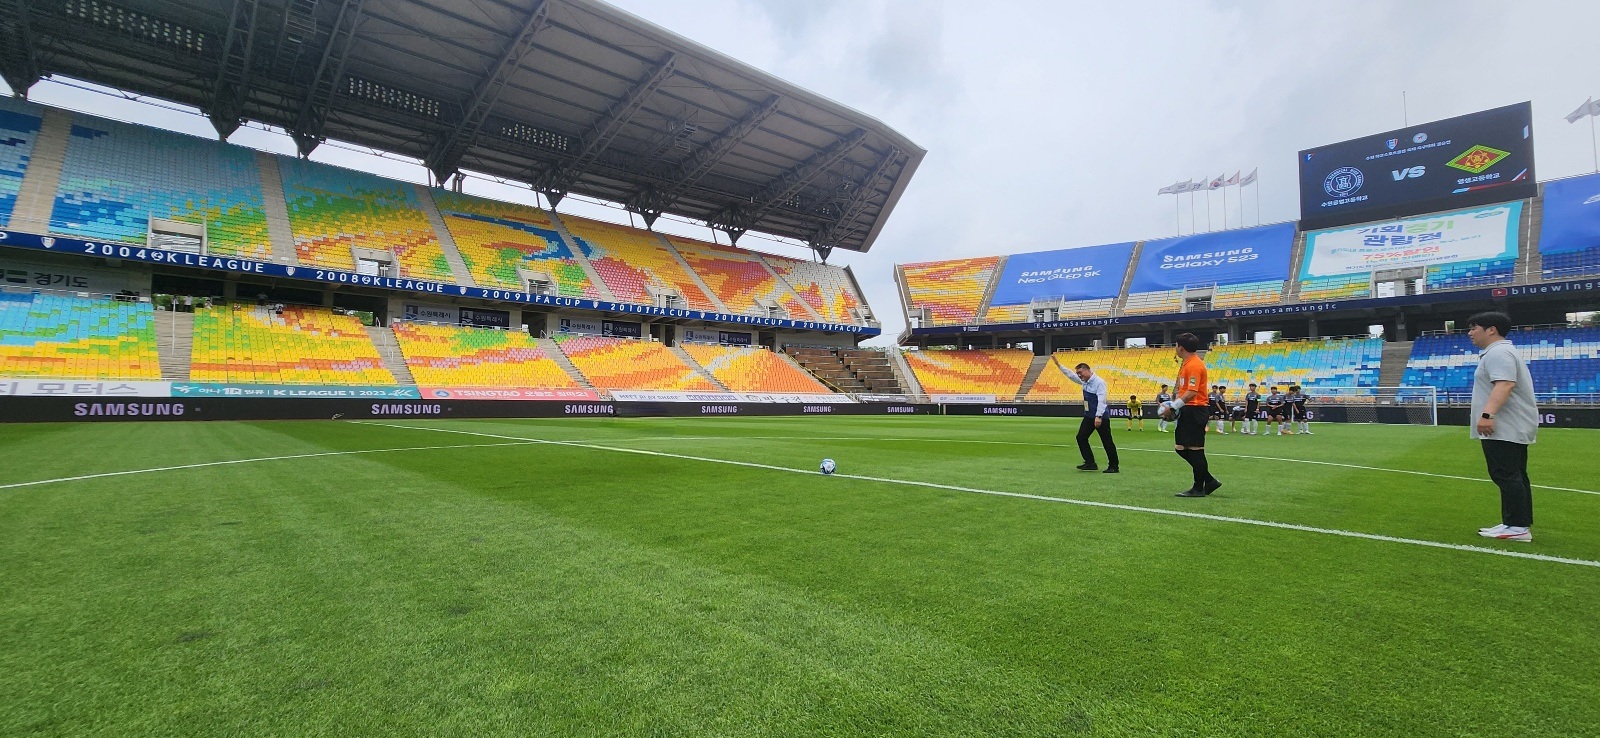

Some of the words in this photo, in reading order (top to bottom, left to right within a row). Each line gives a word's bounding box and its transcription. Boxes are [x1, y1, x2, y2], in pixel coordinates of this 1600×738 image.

[1391, 165, 1426, 181] VS
[84, 242, 147, 260] 2004
[166, 252, 177, 263] K
[185, 254, 264, 273] LEAGUE
[1163, 247, 1253, 262] SAMSUNG
[1160, 258, 1223, 270] Galaxy
[1226, 253, 1259, 264] S23
[1017, 275, 1045, 284] Neo
[1047, 271, 1081, 280] QLED
[1083, 269, 1101, 277] 8K
[1020, 265, 1093, 277] SAMSUNG
[33, 272, 89, 288] 경기도
[316, 270, 359, 284] 2008
[373, 277, 381, 286] K
[386, 278, 444, 293] LEAGUE
[1511, 281, 1600, 295] bluewings
[482, 289, 520, 301] 2009
[535, 295, 550, 304] FA
[555, 297, 581, 307] CUP
[420, 309, 451, 319] 수원특례시
[610, 303, 642, 313] 2010
[653, 307, 665, 316] FA
[669, 309, 691, 318] CUP
[1235, 303, 1337, 316] suwonsamsungfc
[715, 313, 741, 323] 2016
[764, 318, 783, 326] CUP
[1042, 319, 1120, 328] SuwonSamsungFC
[803, 321, 827, 330] 2019
[846, 325, 862, 333] CUP
[31, 382, 139, 395] 모터스
[453, 389, 521, 398] TSINGTAO
[74, 402, 184, 417] SAMSUNG
[371, 403, 441, 415] SAMSUNG
[564, 404, 614, 415] SAMSUNG
[701, 405, 738, 413] SAMSUNG
[803, 405, 832, 413] SAMSUNG
[983, 406, 1018, 414] SAMSUNG
